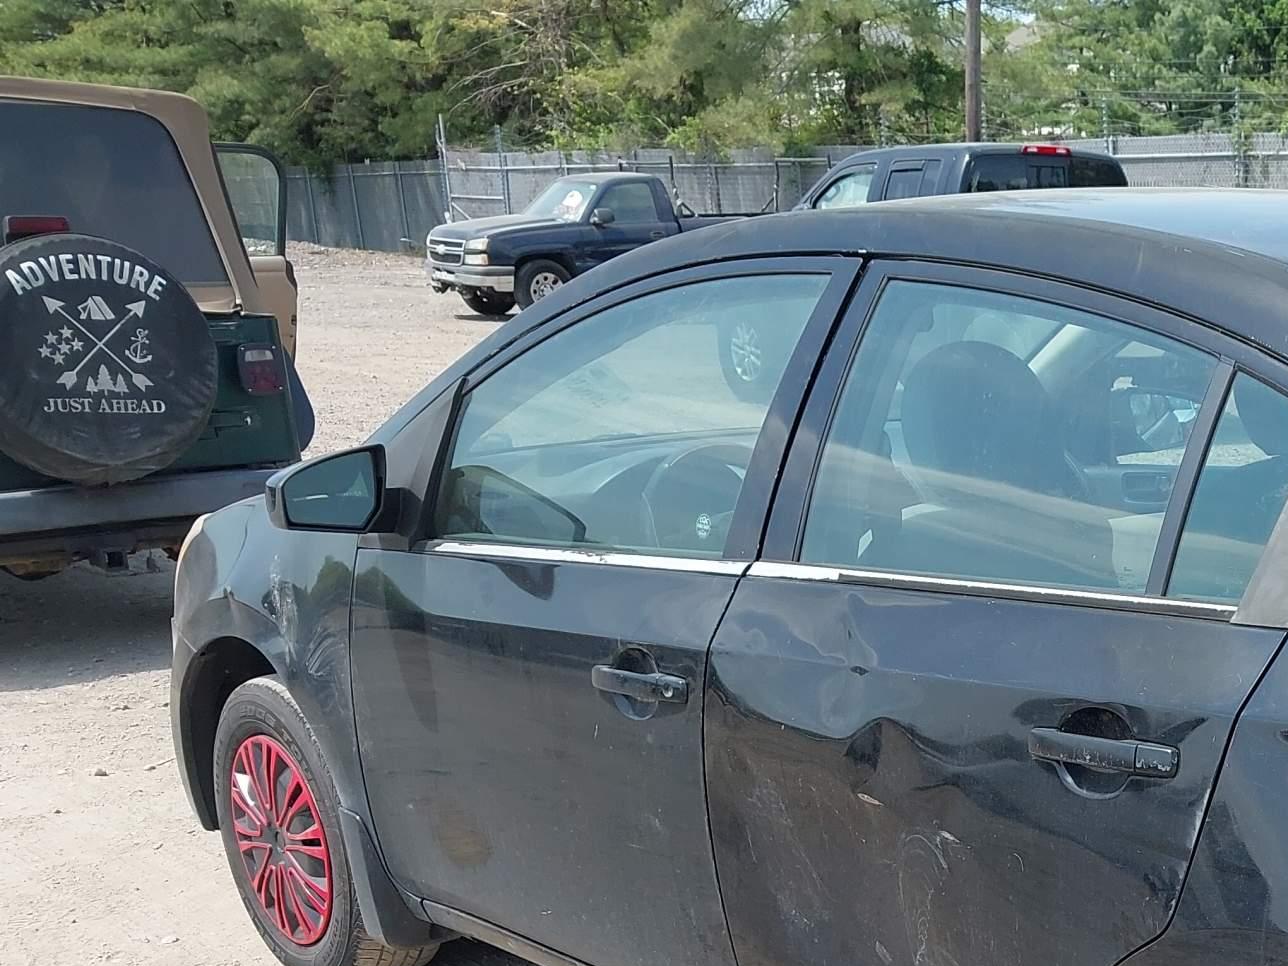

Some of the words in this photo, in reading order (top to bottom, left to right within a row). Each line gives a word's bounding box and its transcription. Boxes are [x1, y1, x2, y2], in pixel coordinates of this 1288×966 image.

[4, 253, 167, 301] ADVENTURE
[43, 398, 94, 414] JUST
[99, 398, 167, 414] AHEAD
